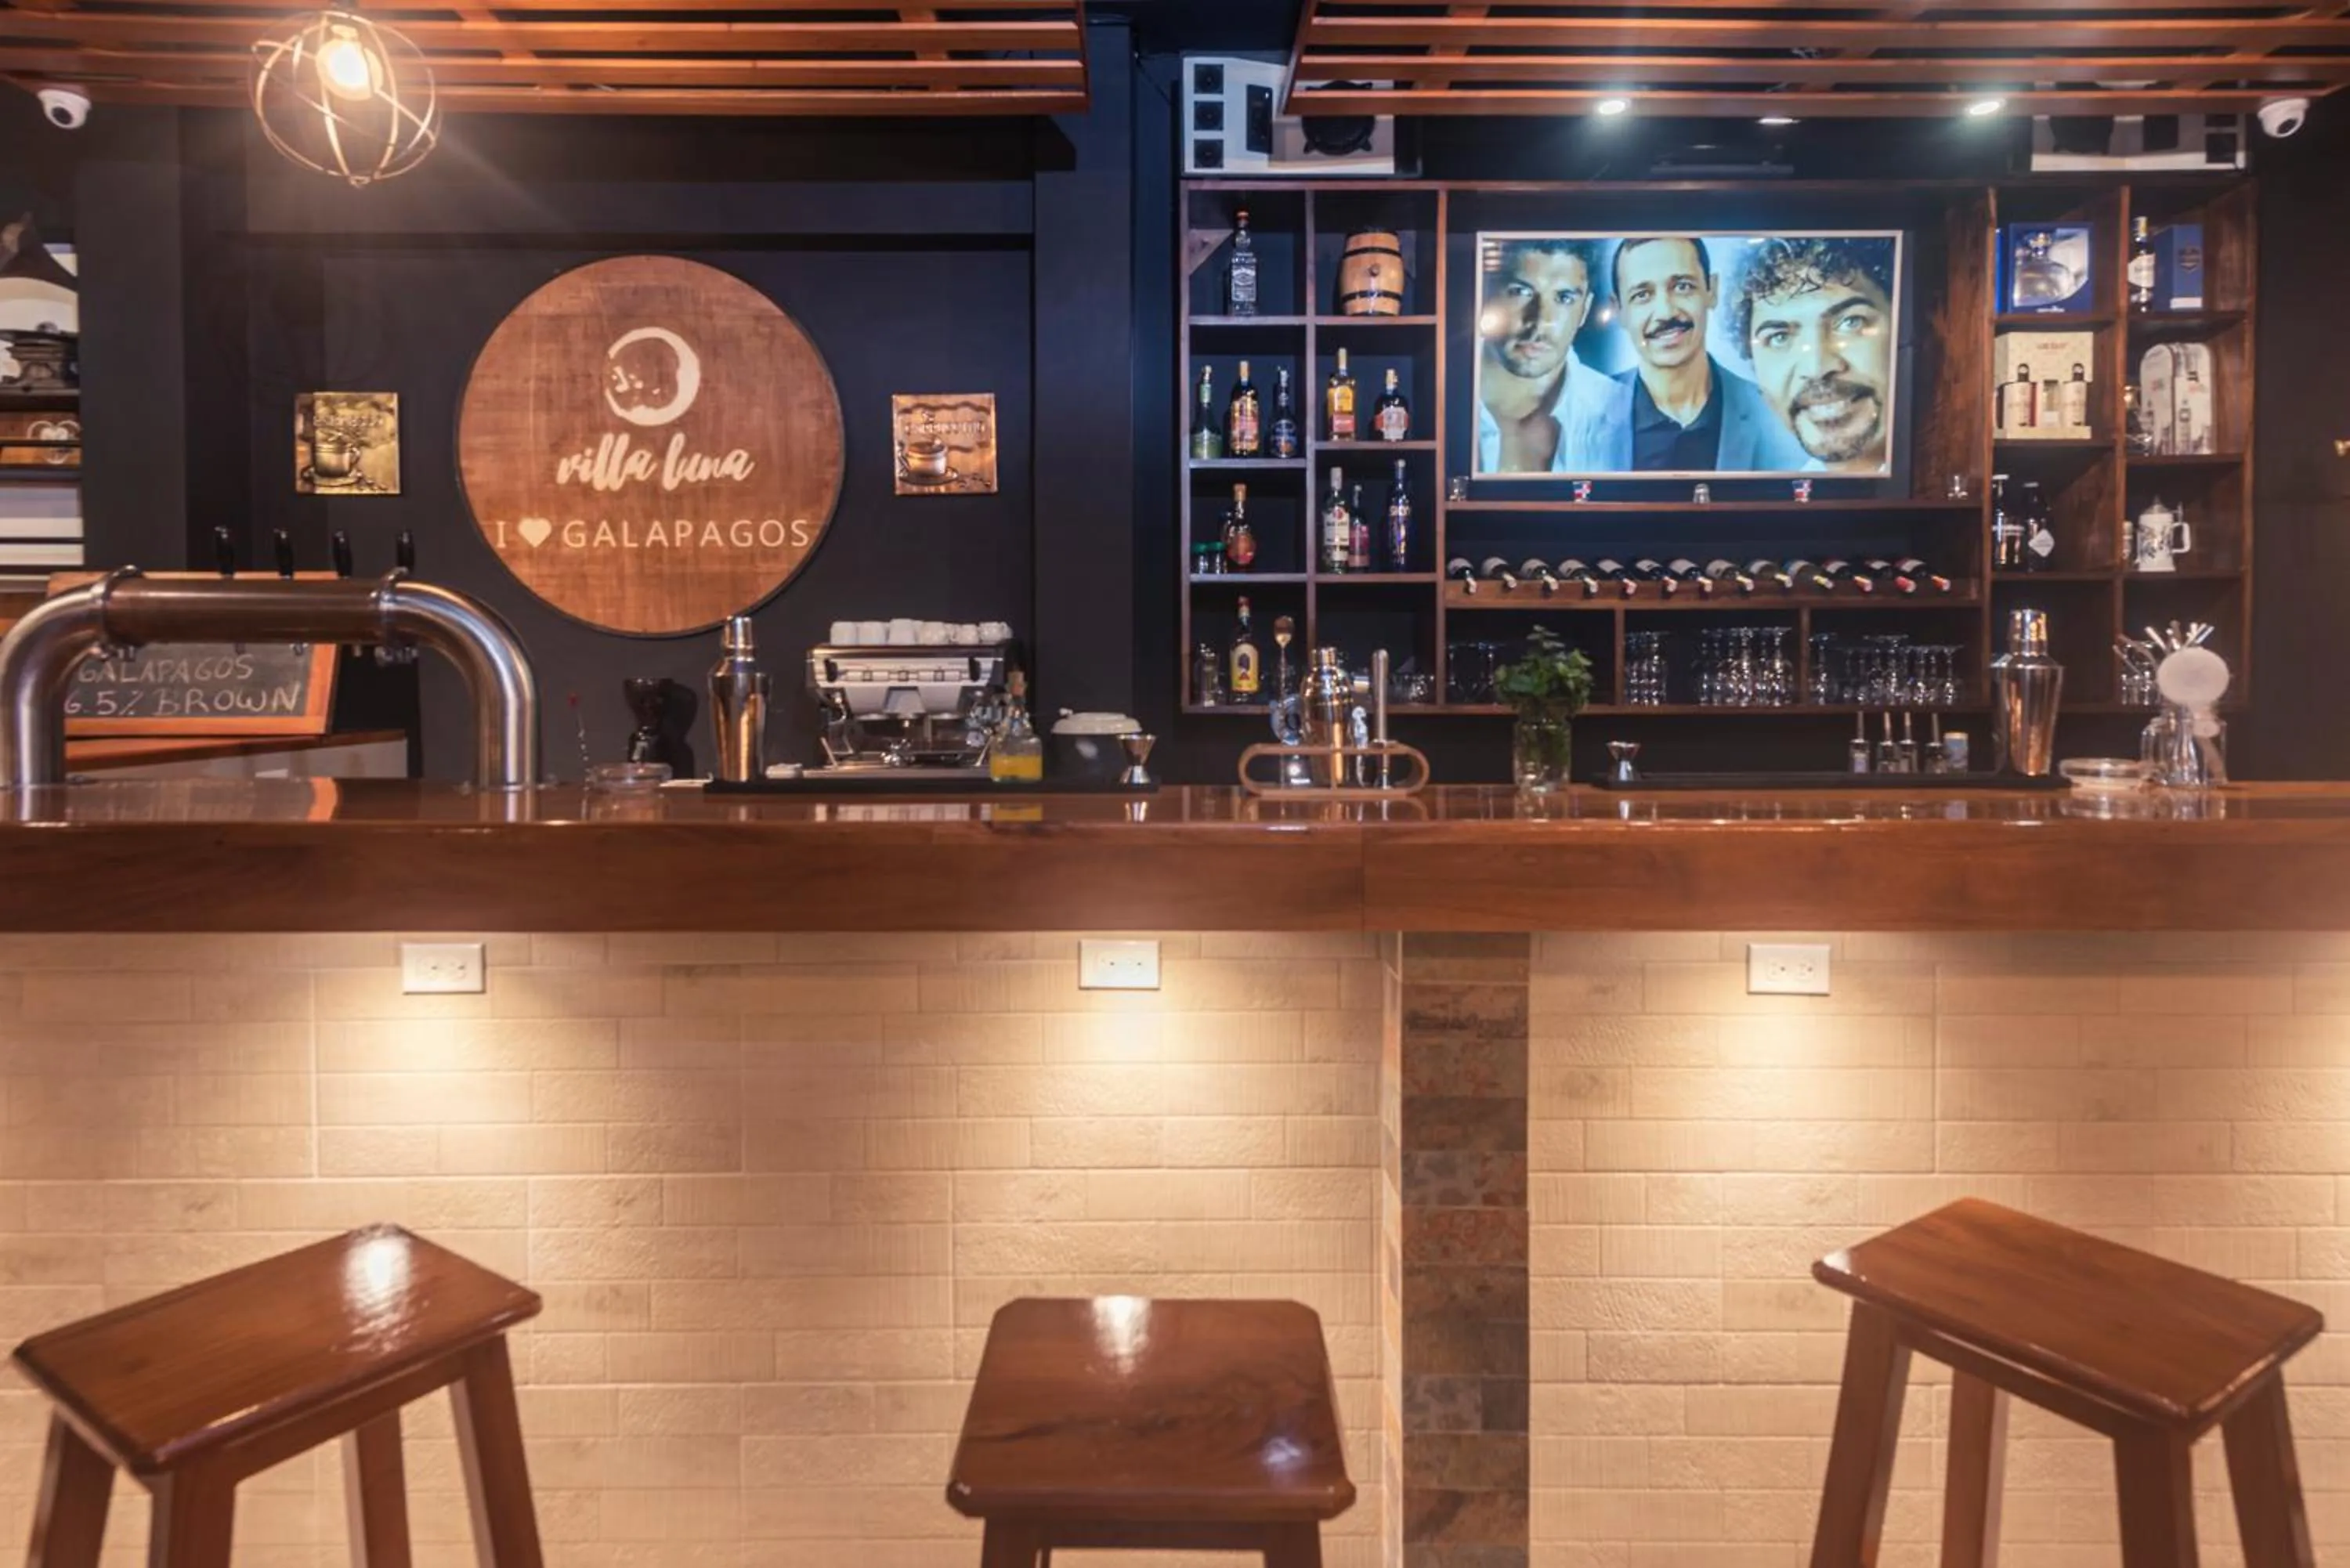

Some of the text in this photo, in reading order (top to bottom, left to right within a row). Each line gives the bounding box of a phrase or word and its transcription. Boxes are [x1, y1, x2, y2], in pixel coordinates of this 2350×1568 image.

[556, 432, 755, 491] villa luna
[497, 519, 810, 548] I GALAPAGOS
[79, 653, 254, 683] GALAPAGOS
[154, 681, 301, 716] BROWN
